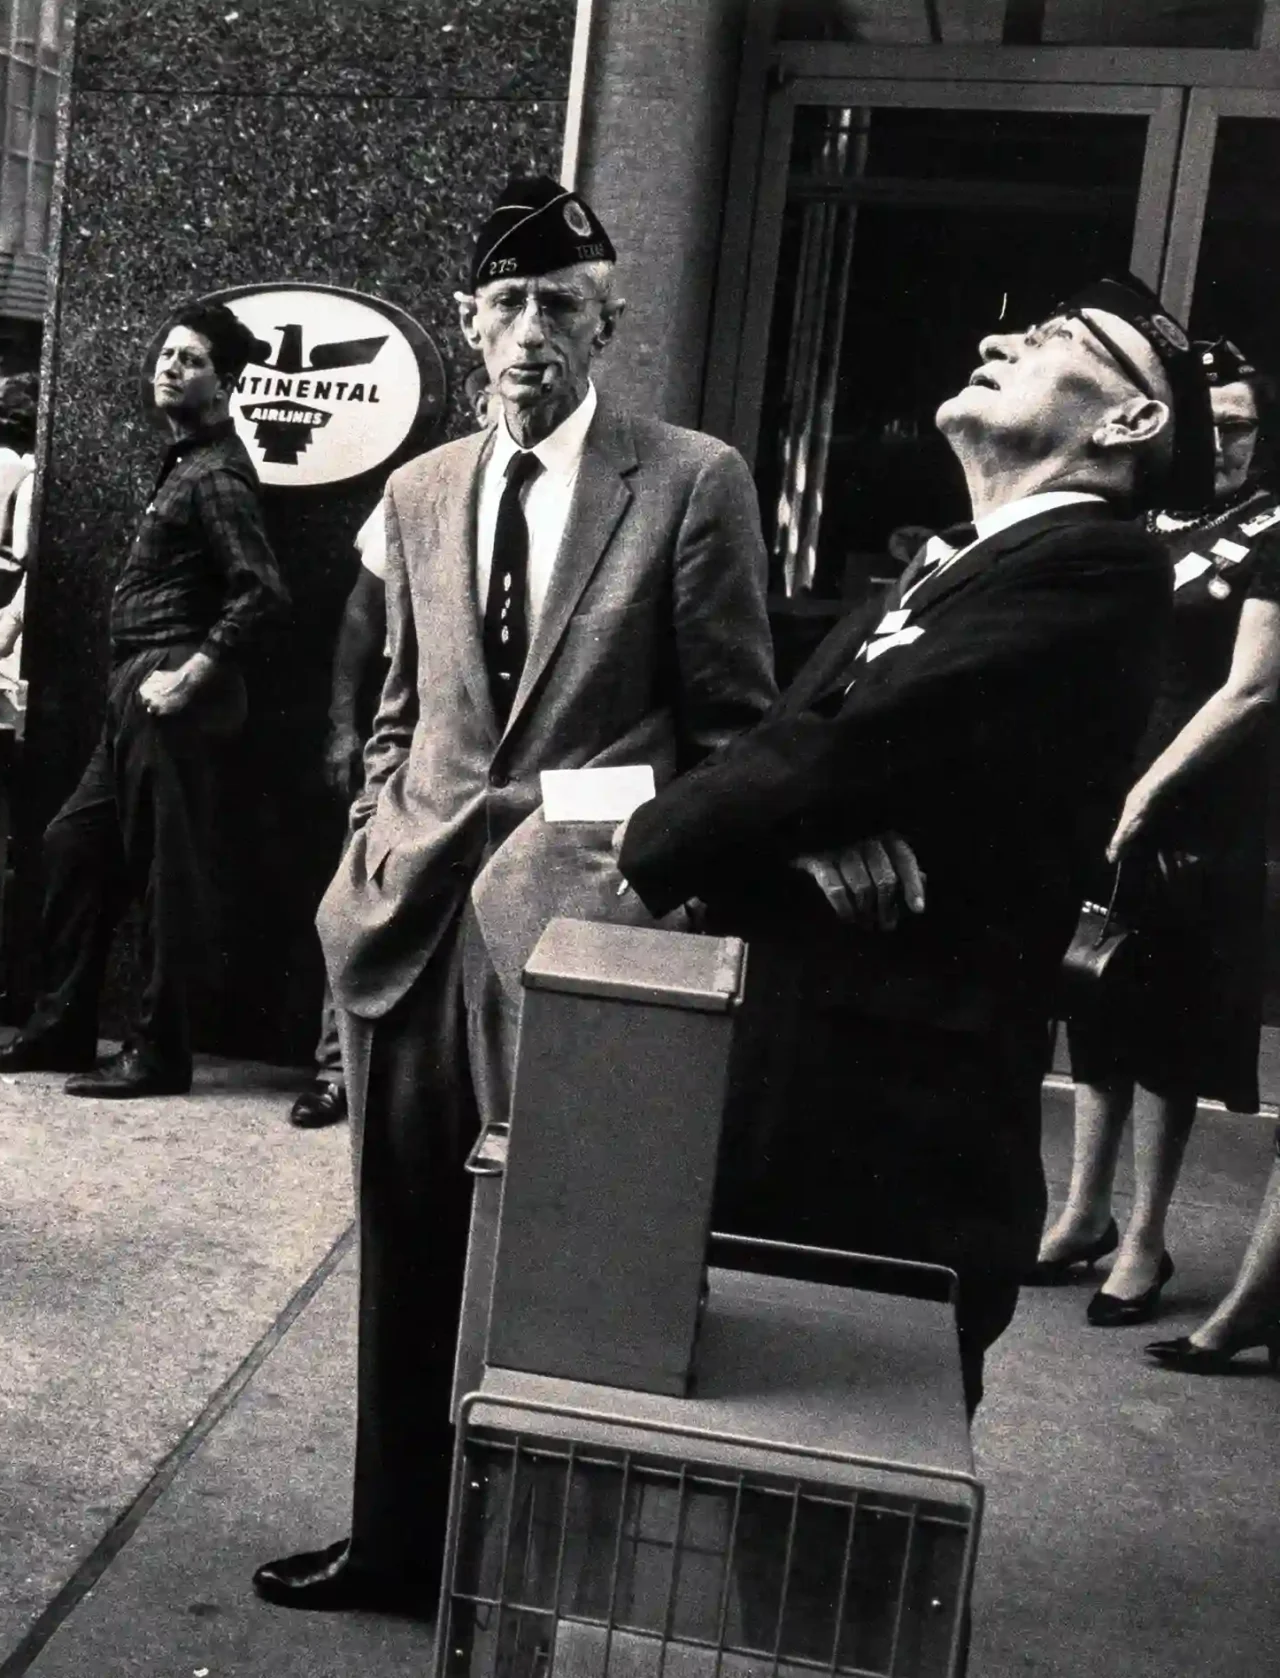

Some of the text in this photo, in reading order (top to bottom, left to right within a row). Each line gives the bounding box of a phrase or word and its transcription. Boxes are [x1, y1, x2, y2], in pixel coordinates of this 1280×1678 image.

[489, 258, 518, 275] 275
[236, 376, 380, 403] NTINENTAL
[250, 407, 324, 425] AIRLINES
